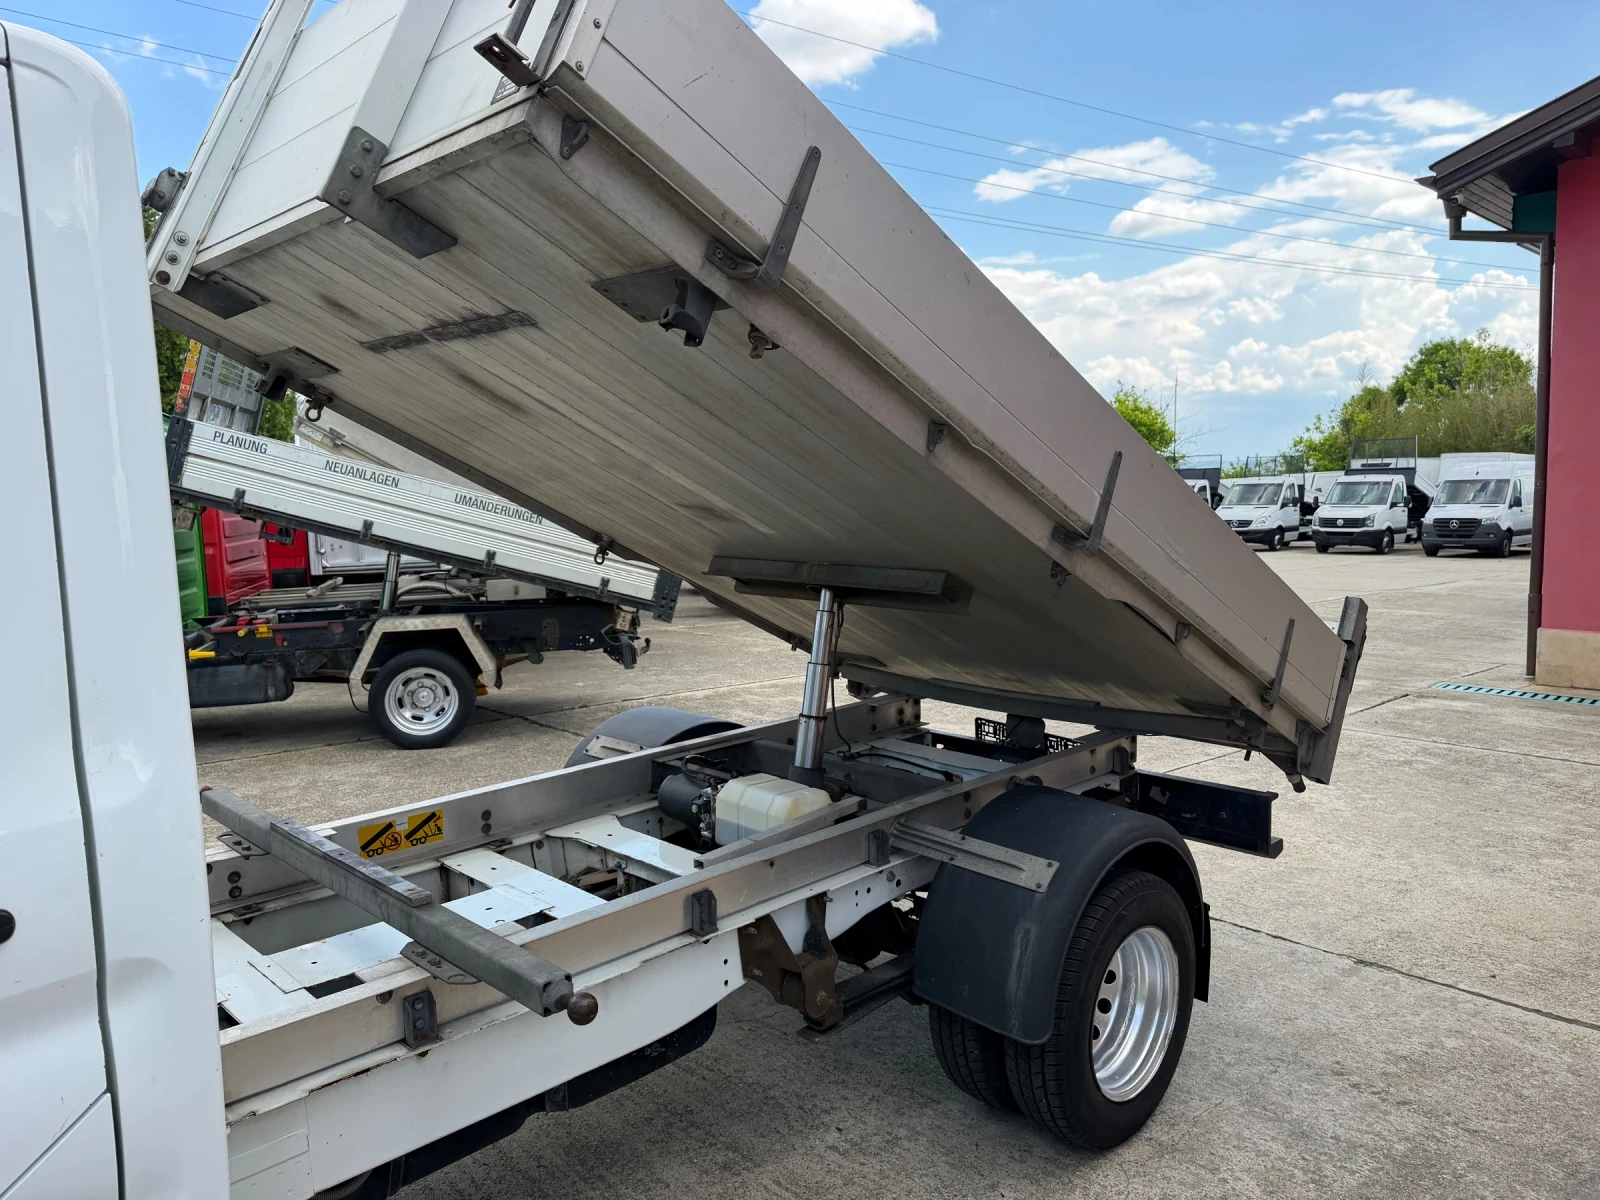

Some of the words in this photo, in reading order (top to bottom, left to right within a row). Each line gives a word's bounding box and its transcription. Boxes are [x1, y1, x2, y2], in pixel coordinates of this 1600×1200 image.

[213, 430, 268, 454] PLANUNG
[324, 459, 400, 488] NEUANLAGEN
[454, 493, 543, 525] UMÄNDERUNGEN
